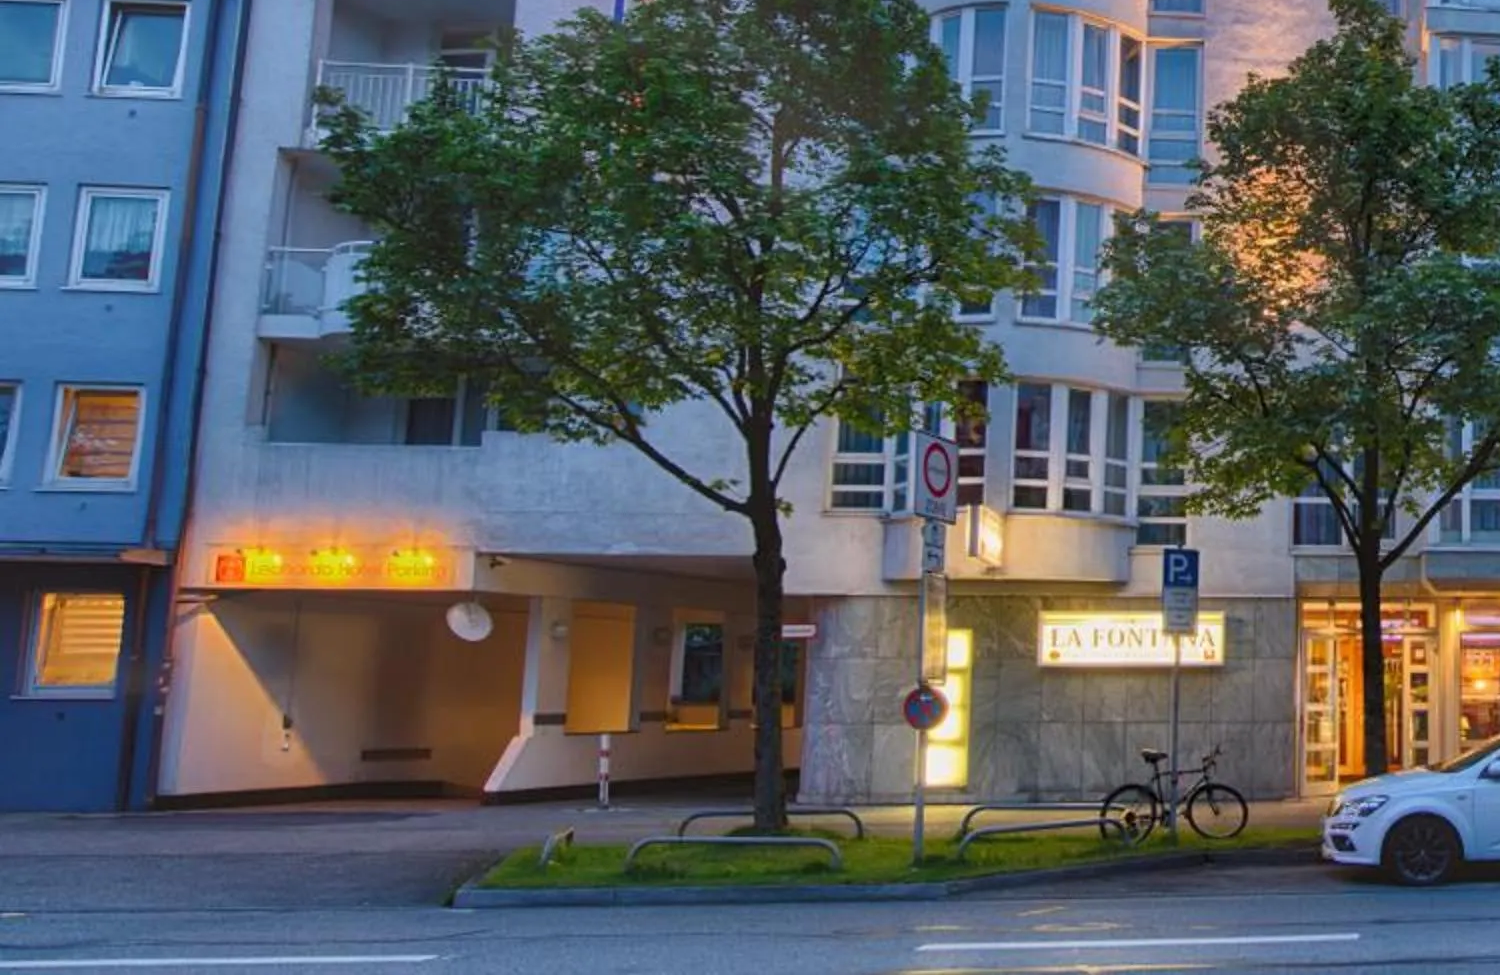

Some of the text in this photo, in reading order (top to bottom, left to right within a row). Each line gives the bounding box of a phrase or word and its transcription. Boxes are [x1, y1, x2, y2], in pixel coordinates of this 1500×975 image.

[386, 562, 449, 579] Parking
[1169, 553, 1189, 583] P
[1050, 627, 1082, 648] LA
